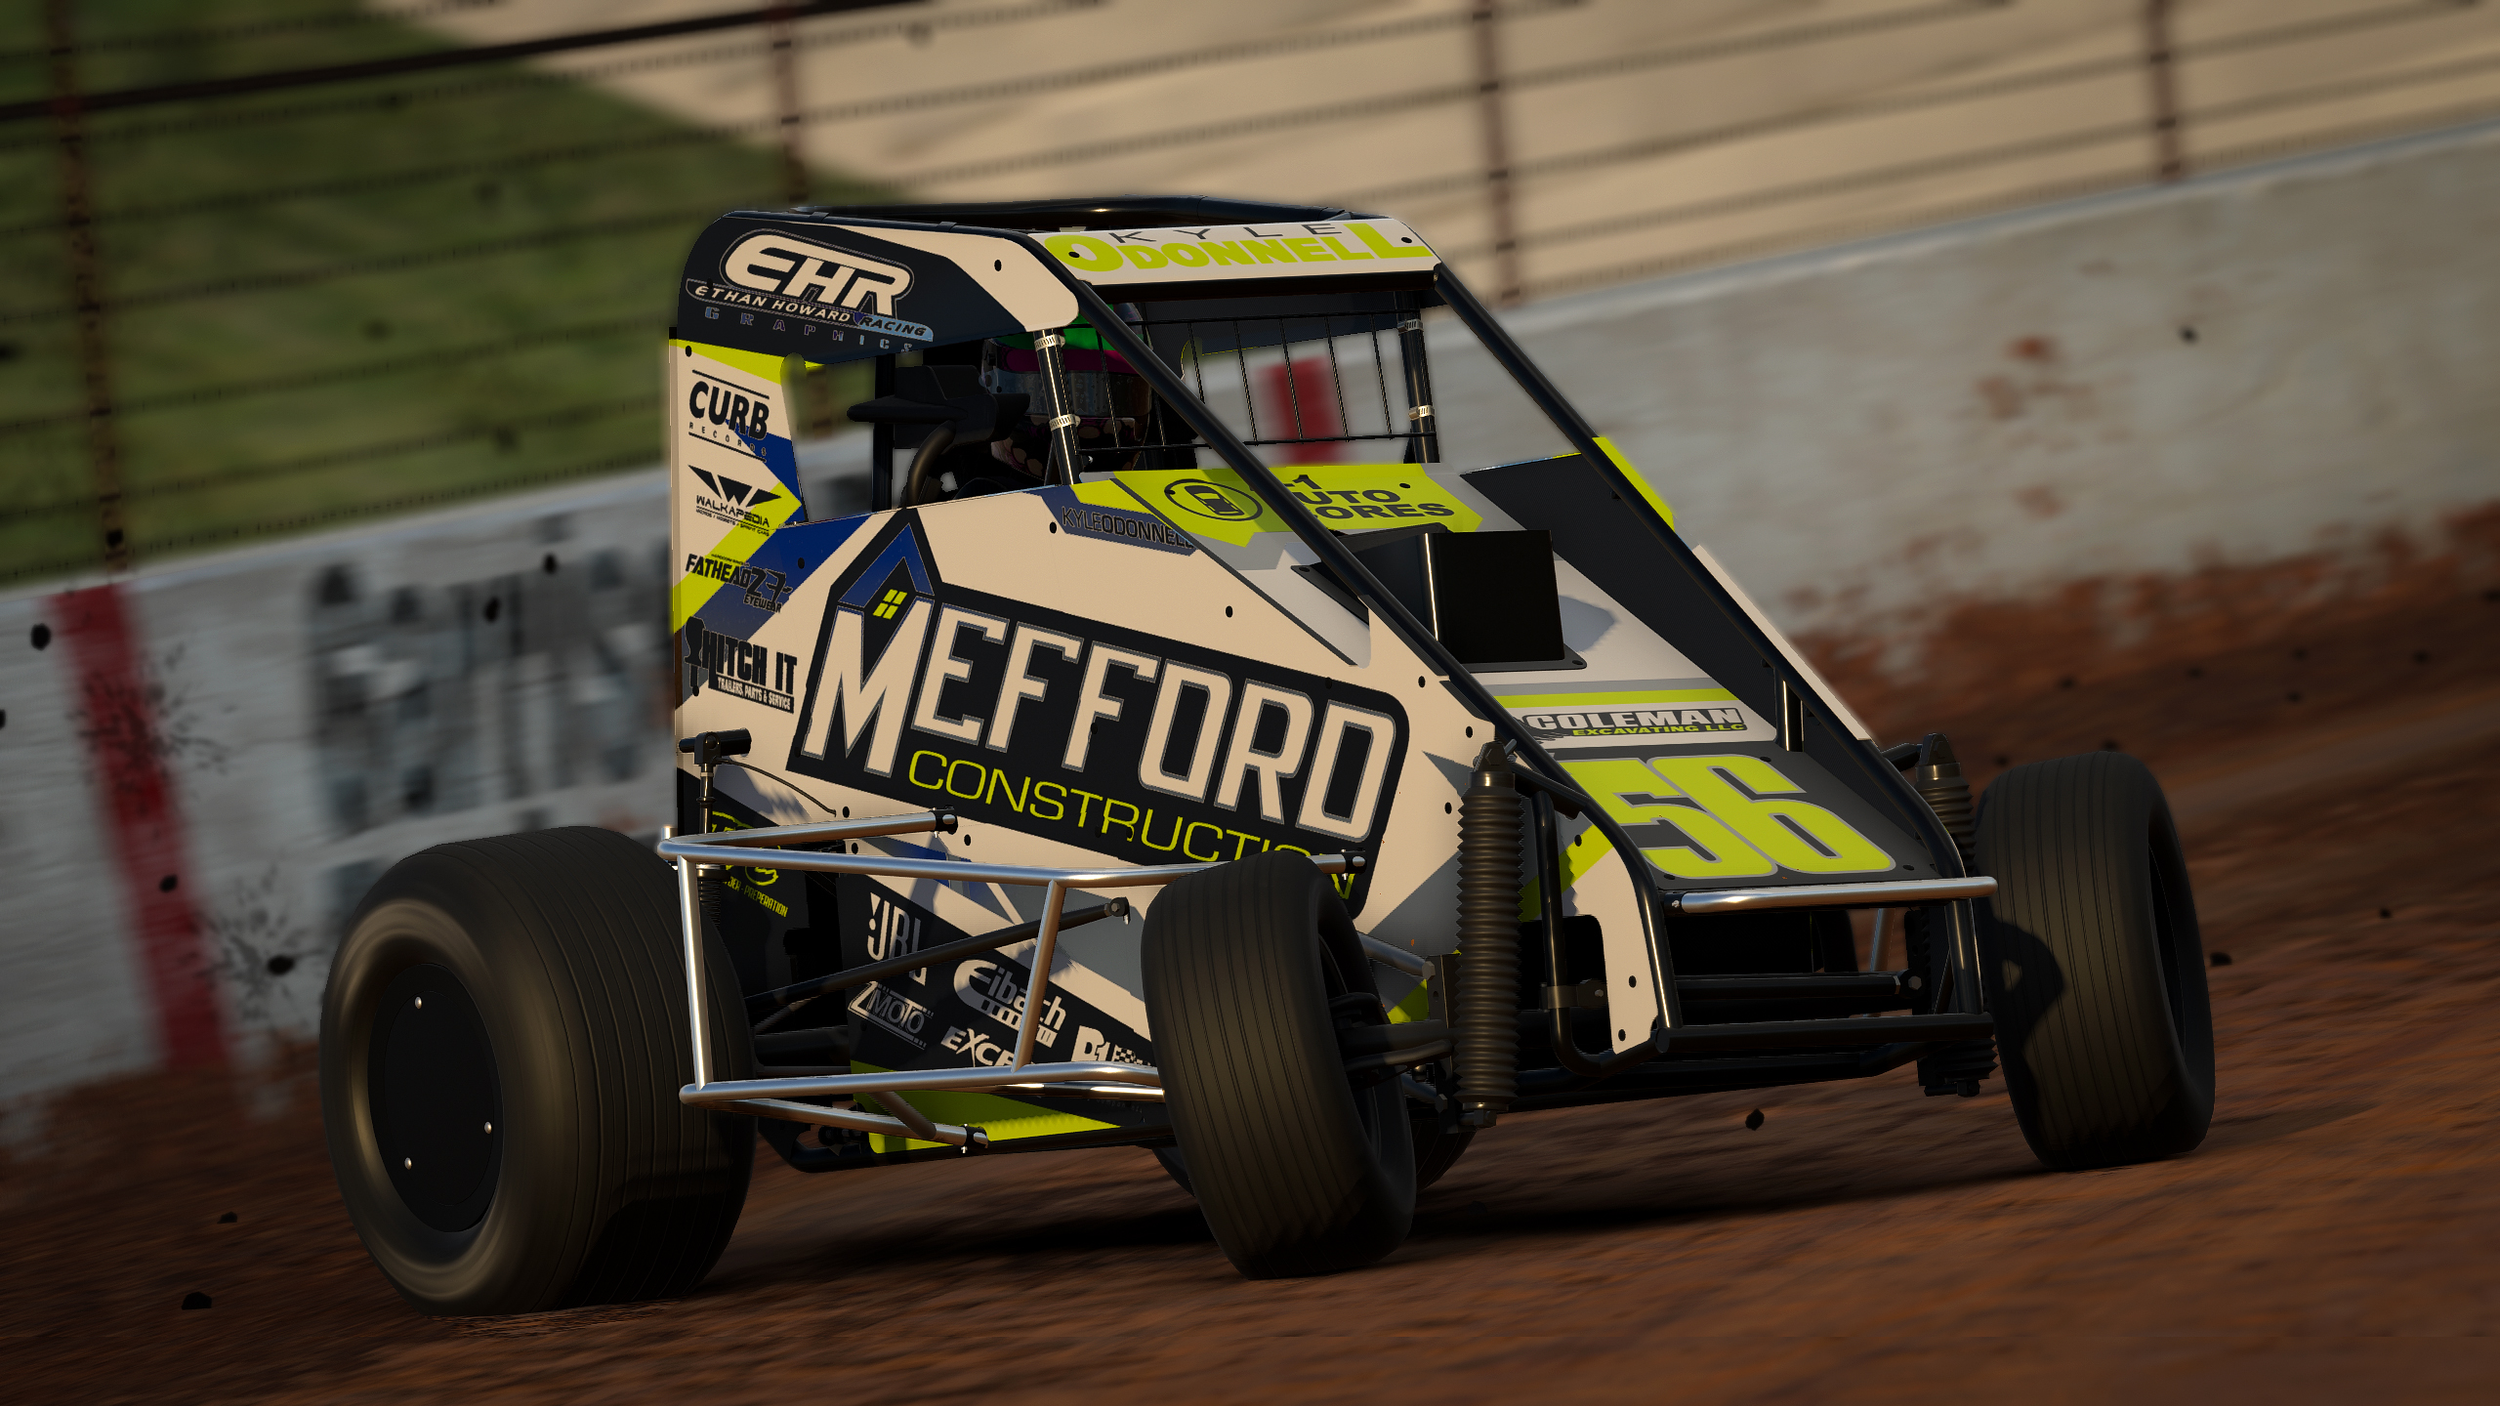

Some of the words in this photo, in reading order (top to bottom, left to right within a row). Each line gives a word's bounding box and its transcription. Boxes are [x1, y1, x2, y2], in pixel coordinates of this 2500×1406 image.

[1044, 222, 1434, 272] ODONNELL
[1108, 222, 1343, 244] KYLE
[725, 233, 911, 316] EHR
[695, 286, 767, 308] ETHAN
[771, 300, 851, 323] HOWARD
[857, 316, 928, 337] RACING
[704, 306, 913, 353] GRAPHICS
[689, 381, 770, 440] CURB
[689, 421, 767, 457] RECORDS
[696, 494, 770, 528] WALKAPEDIA
[1292, 489, 1401, 505] UTO
[1313, 503, 1455, 519] ORES
[702, 629, 768, 688] HITCH
[775, 651, 798, 695] IT
[744, 686, 763, 702] PARTS
[768, 692, 791, 710] SERVICE
[802, 595, 1396, 843] MEFFORD
[1526, 708, 1744, 731] COLEMAN
[1572, 725, 1700, 737] EXCAVATING
[1705, 723, 1745, 732] LLC
[908, 750, 1357, 899] CONSTRUCT
[1558, 754, 1897, 879] 56
[953, 959, 1067, 1032] Eibah
[940, 1025, 1016, 1068] EXCE
